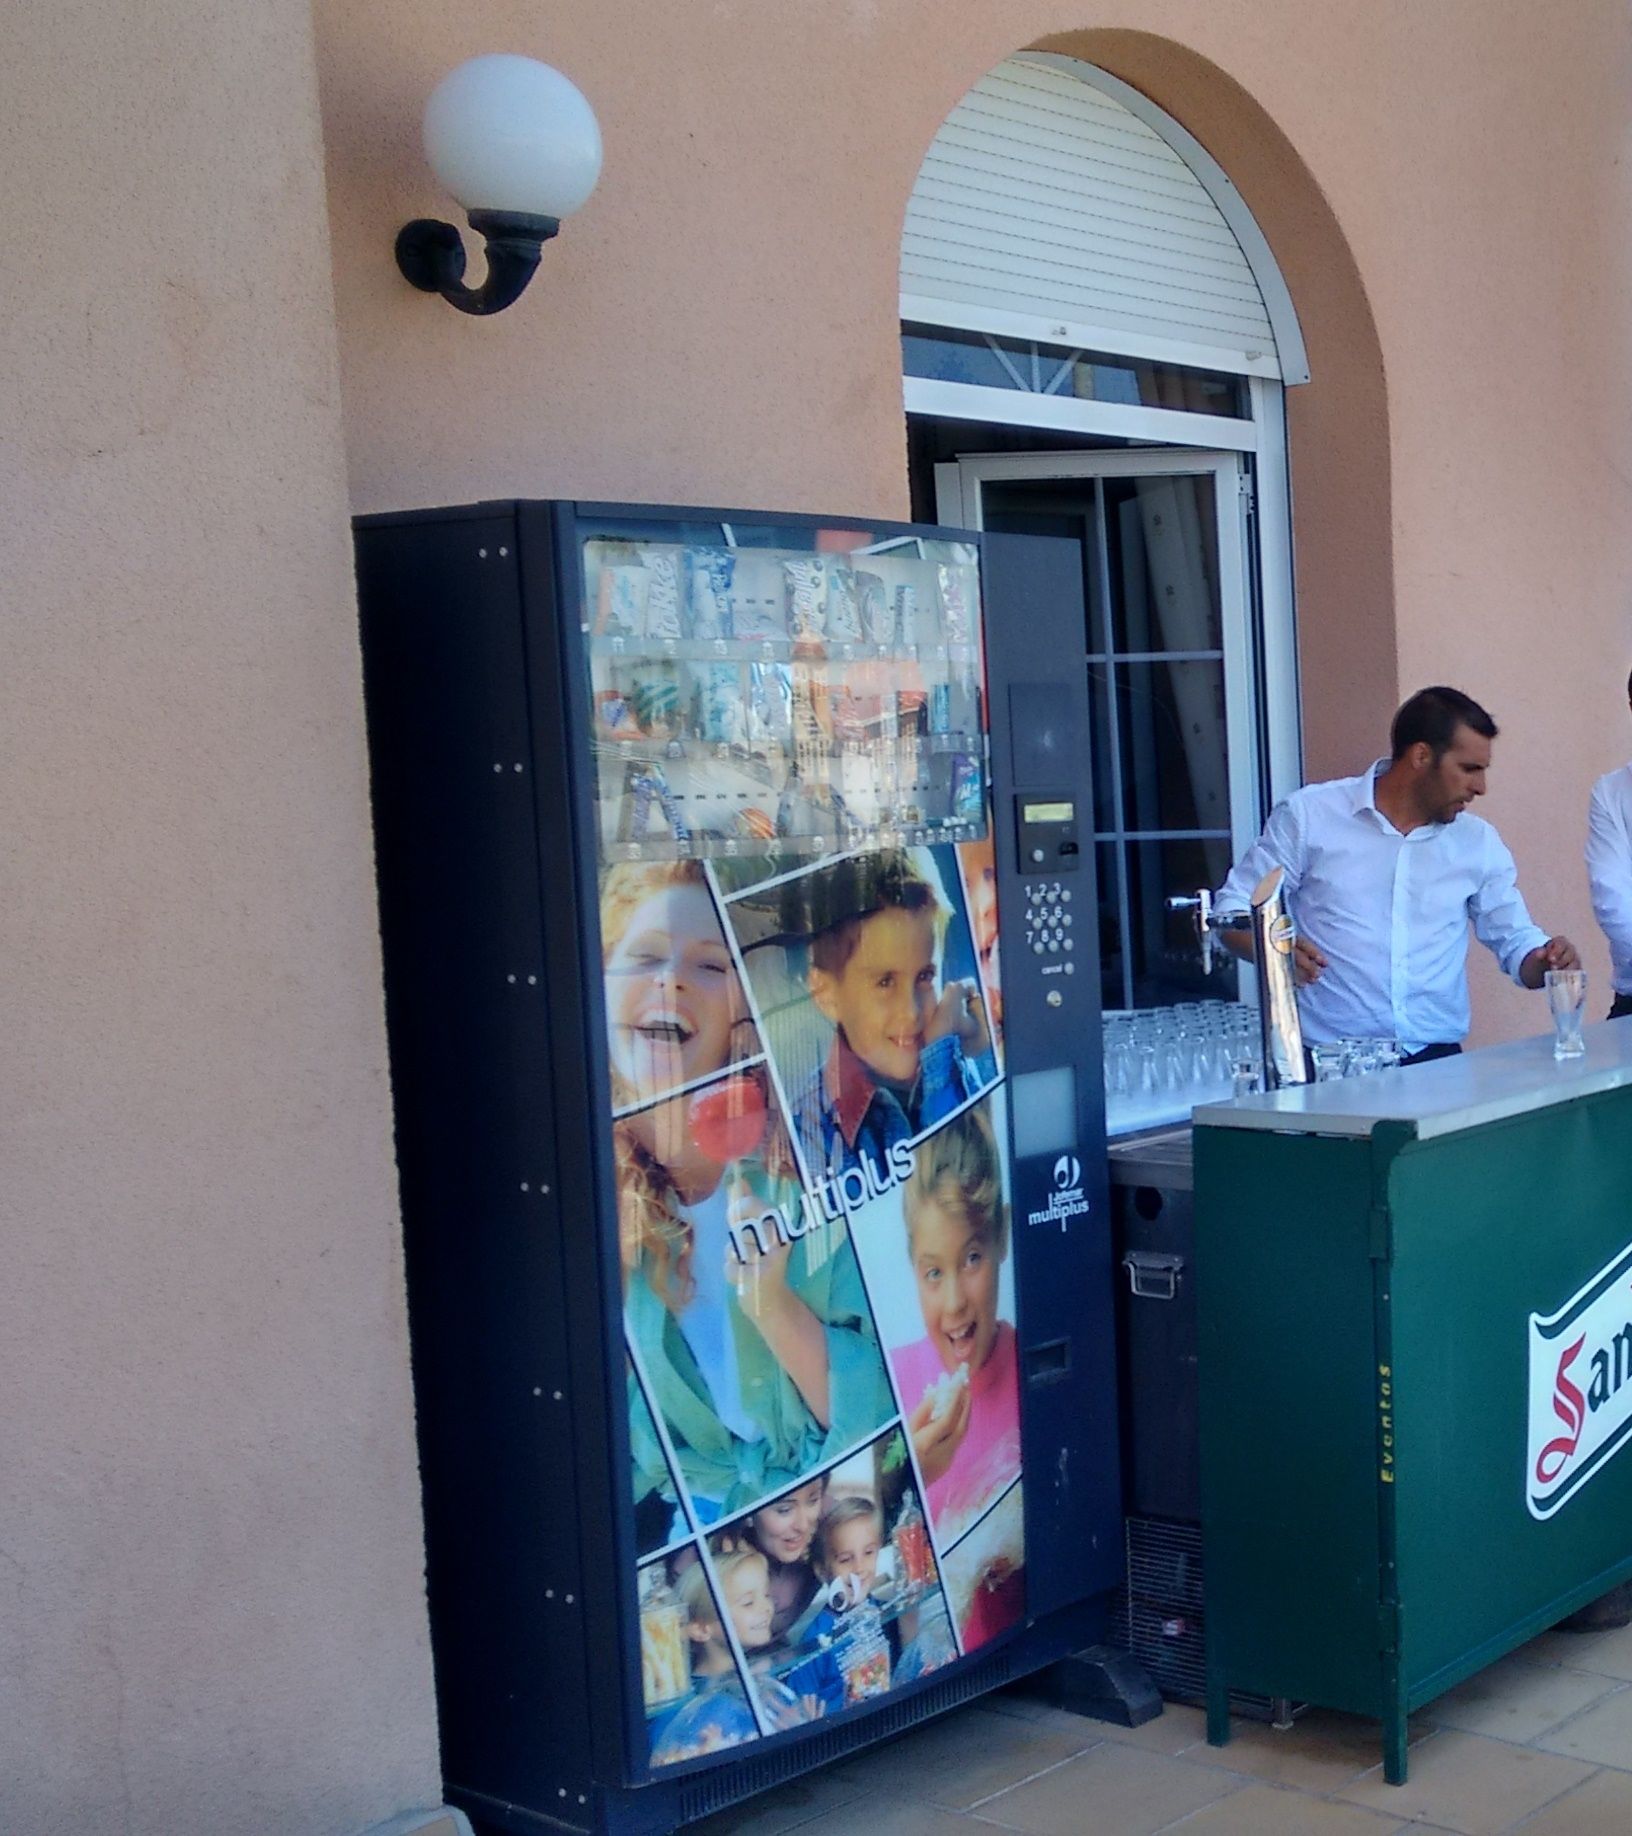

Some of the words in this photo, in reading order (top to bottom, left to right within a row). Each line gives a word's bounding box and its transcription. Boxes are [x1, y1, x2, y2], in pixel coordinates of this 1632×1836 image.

[1025, 886, 1031, 897] 1
[1039, 884, 1047, 896] 2
[1054, 882, 1061, 895] 3
[1025, 909, 1033, 920] 4
[1040, 907, 1048, 920] 5
[1054, 905, 1062, 918] 6
[1026, 931, 1034, 944] 7
[1041, 929, 1049, 942] 8
[1055, 928, 1063, 941] 9
[730, 1138, 917, 1265] multiplus
[1028, 1193, 1090, 1233] multiplus
[1378, 1364, 1394, 1483] Eventos
